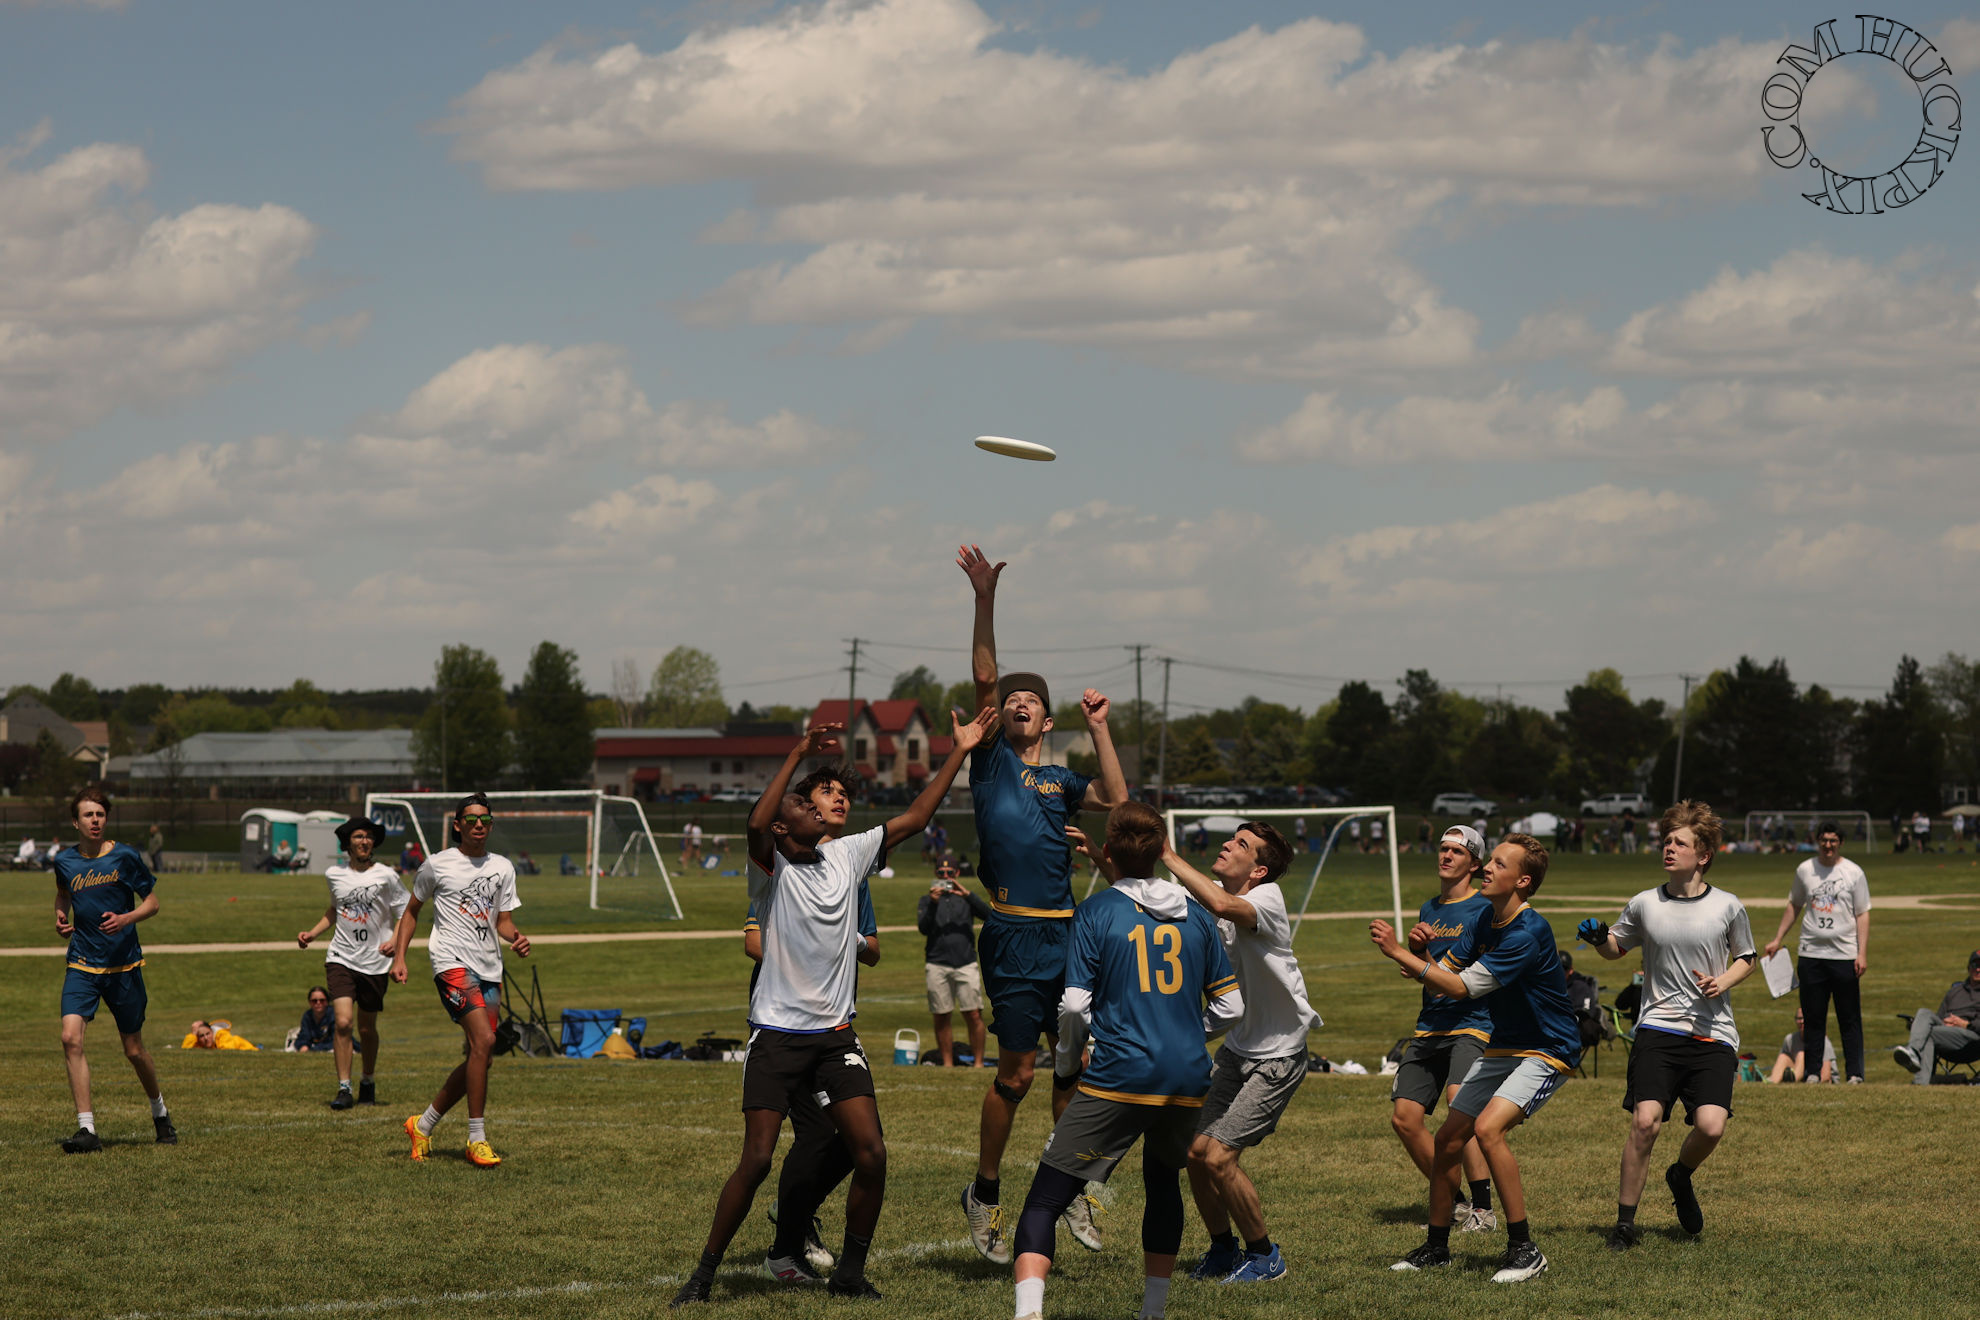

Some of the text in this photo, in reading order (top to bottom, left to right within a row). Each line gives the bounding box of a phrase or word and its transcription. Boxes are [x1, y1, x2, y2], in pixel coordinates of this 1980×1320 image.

[70, 868, 121, 892] Wildcats
[1431, 918, 1464, 938] ldcats
[1818, 917, 1835, 930] 32
[353, 928, 368, 942] 10
[475, 926, 487, 941] 17
[1127, 924, 1184, 995] 13
